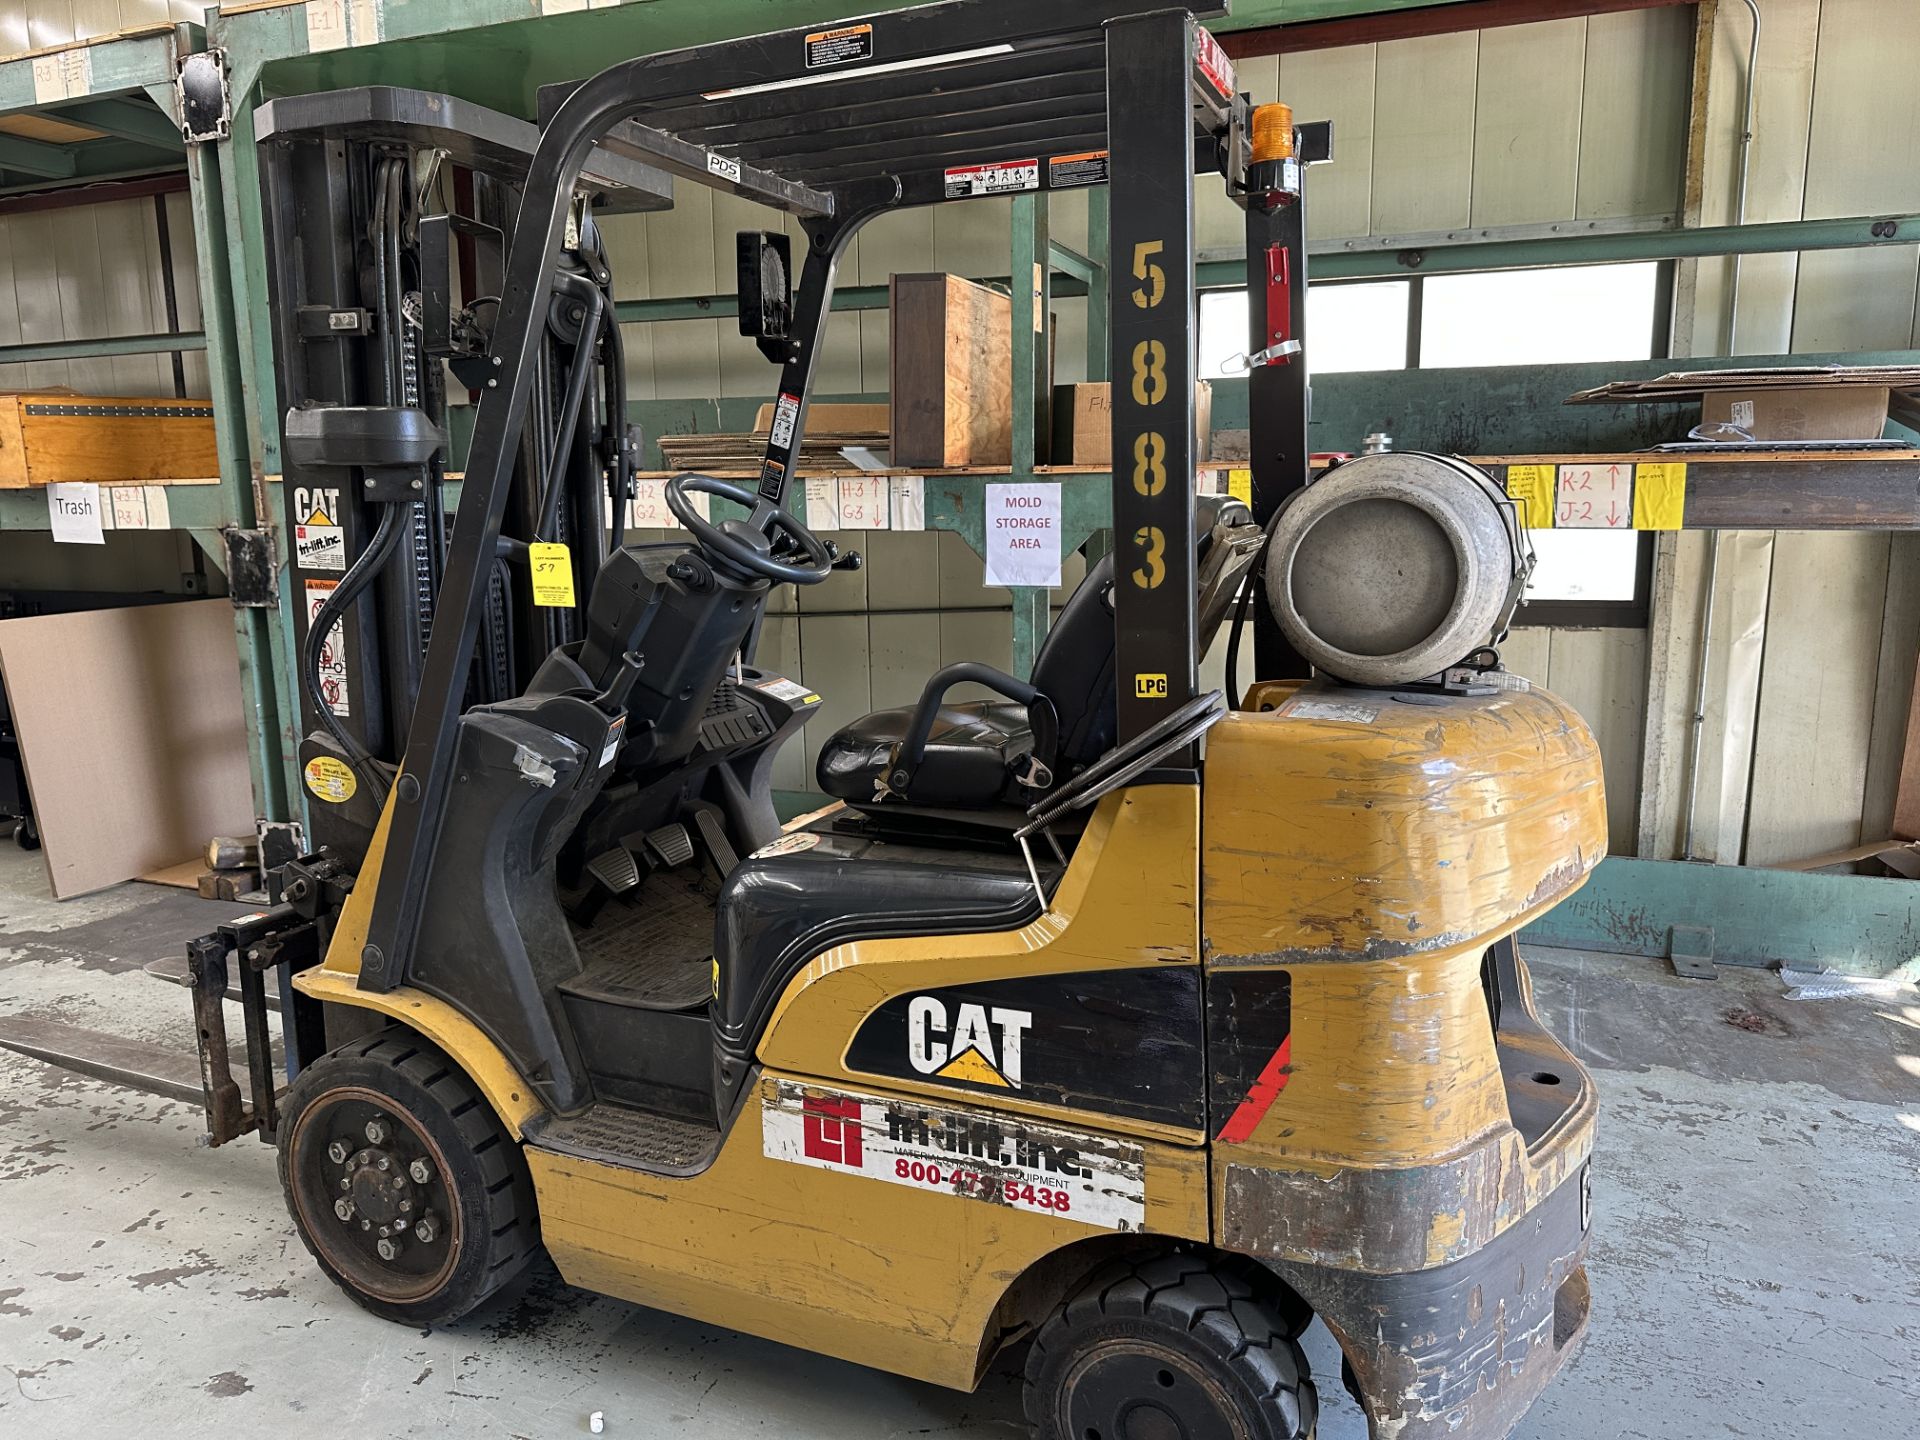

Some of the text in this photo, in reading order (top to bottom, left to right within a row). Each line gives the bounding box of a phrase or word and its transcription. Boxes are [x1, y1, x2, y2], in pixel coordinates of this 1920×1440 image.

[711, 156, 738, 175] PDS
[842, 481, 864, 499] H-3
[1562, 471, 1592, 492] K-2
[56, 498, 92, 515] Trash
[294, 487, 340, 526] CAT
[1005, 497, 1042, 508] MOLD
[637, 504, 656, 519] G-2
[1561, 501, 1593, 522] J-2
[996, 518, 1051, 529] STORAGE
[1009, 538, 1041, 549] AREA
[536, 563, 555, 572] 57
[1137, 679, 1166, 693] LPG
[908, 996, 1032, 1090] CAT
